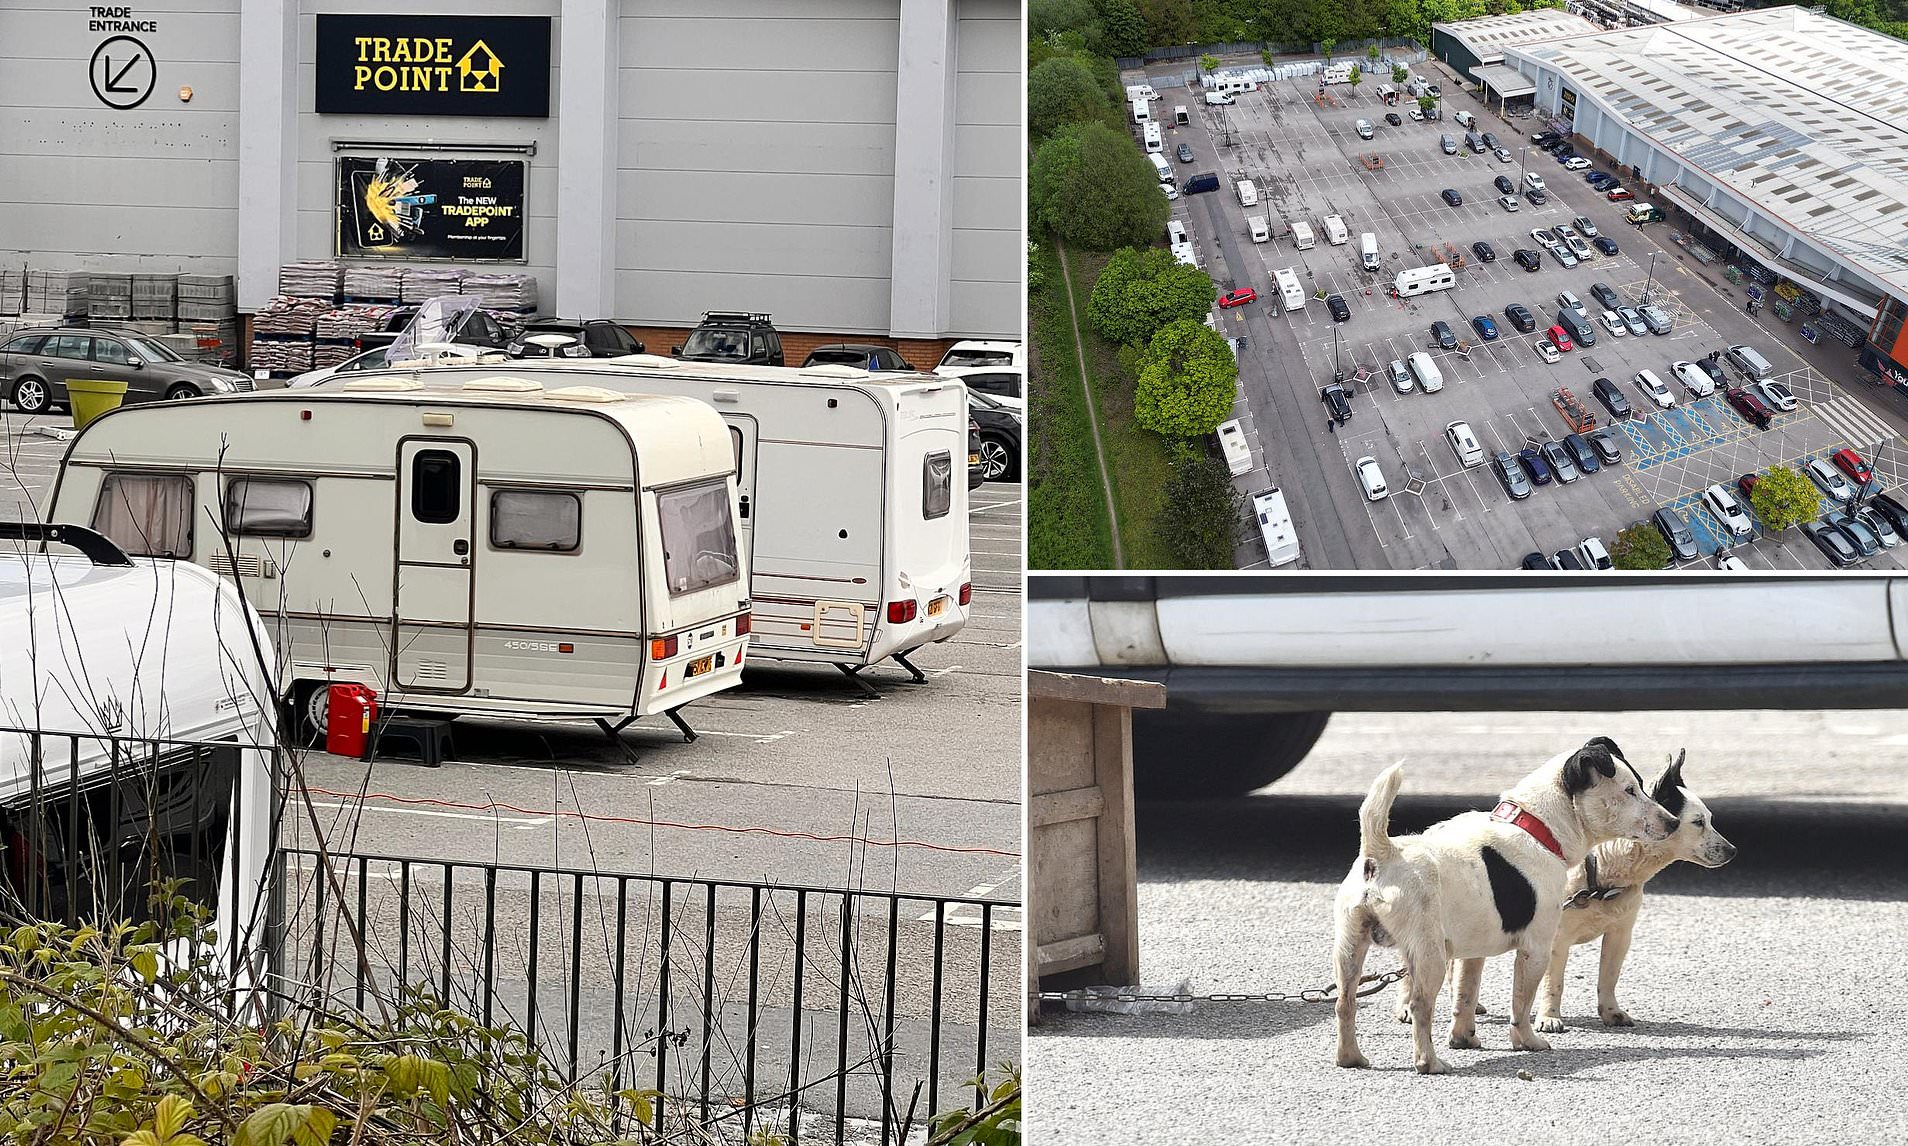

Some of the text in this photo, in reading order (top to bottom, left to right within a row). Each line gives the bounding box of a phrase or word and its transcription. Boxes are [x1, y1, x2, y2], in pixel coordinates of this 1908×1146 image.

[89, 6, 131, 18] TRADE
[89, 20, 157, 32] ENTRANCE
[355, 37, 453, 63] TRADE
[354, 65, 453, 92] POINT
[458, 196, 497, 205] The NEW
[441, 205, 514, 217] TRADEPOINT
[464, 216, 490, 228] APP
